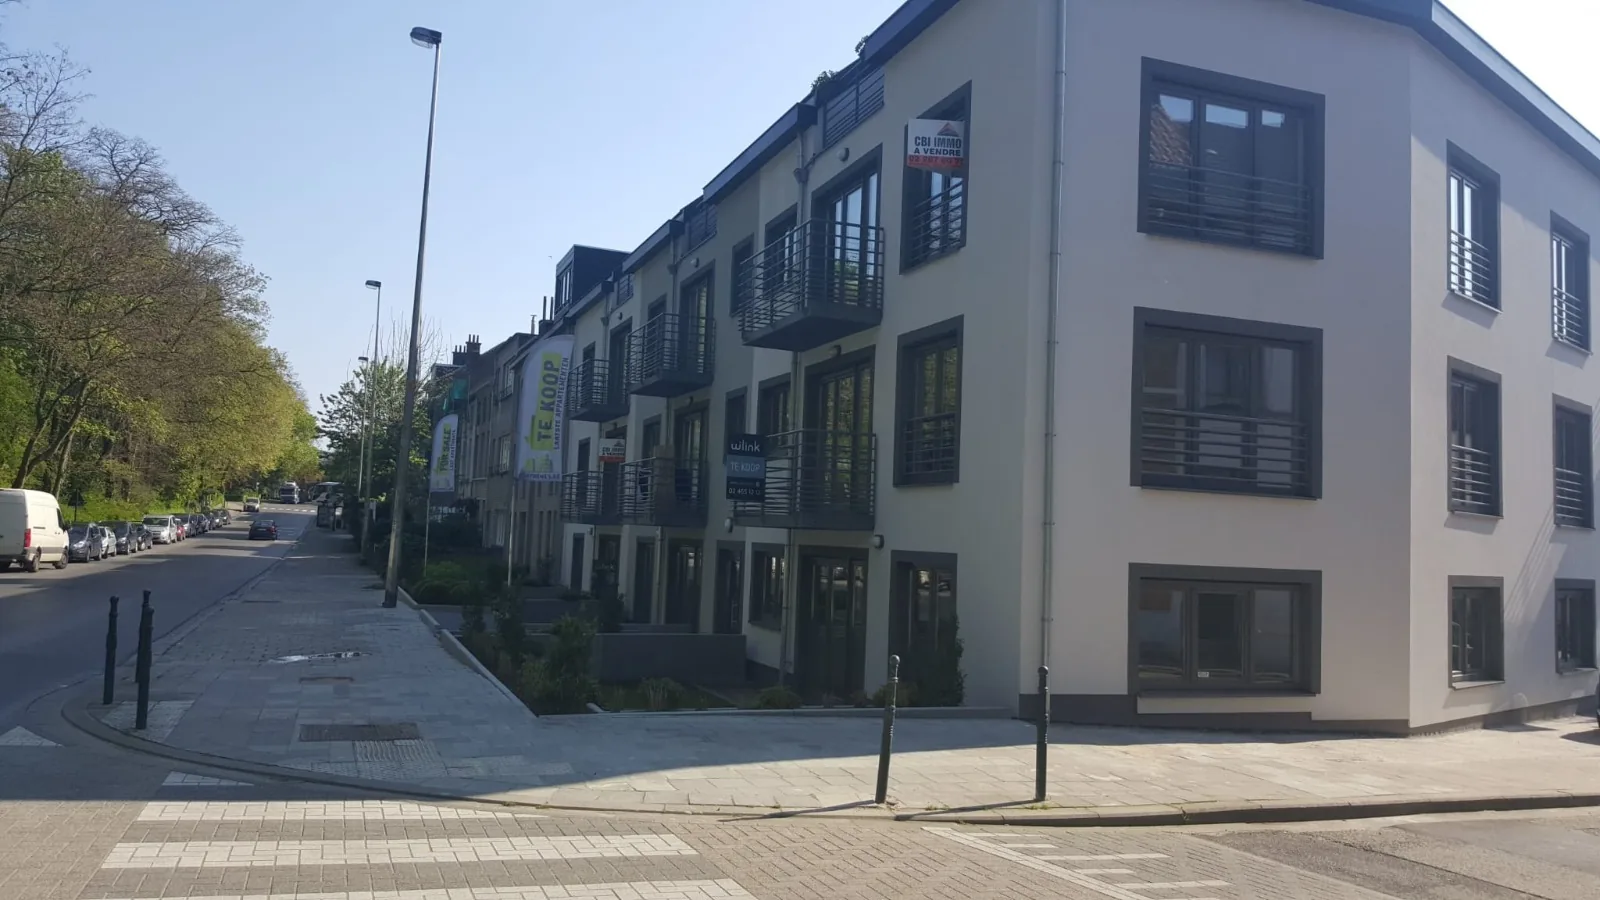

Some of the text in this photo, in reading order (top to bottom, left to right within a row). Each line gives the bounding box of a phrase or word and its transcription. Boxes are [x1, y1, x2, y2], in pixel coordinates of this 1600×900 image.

[914, 136, 962, 149] CBI IMMO
[923, 148, 961, 157] VENDRE
[555, 357, 569, 418] APPARTEMENTEN
[536, 360, 560, 442] TE KOOP
[731, 440, 760, 452] wilink
[731, 461, 760, 472] TE KOOP
